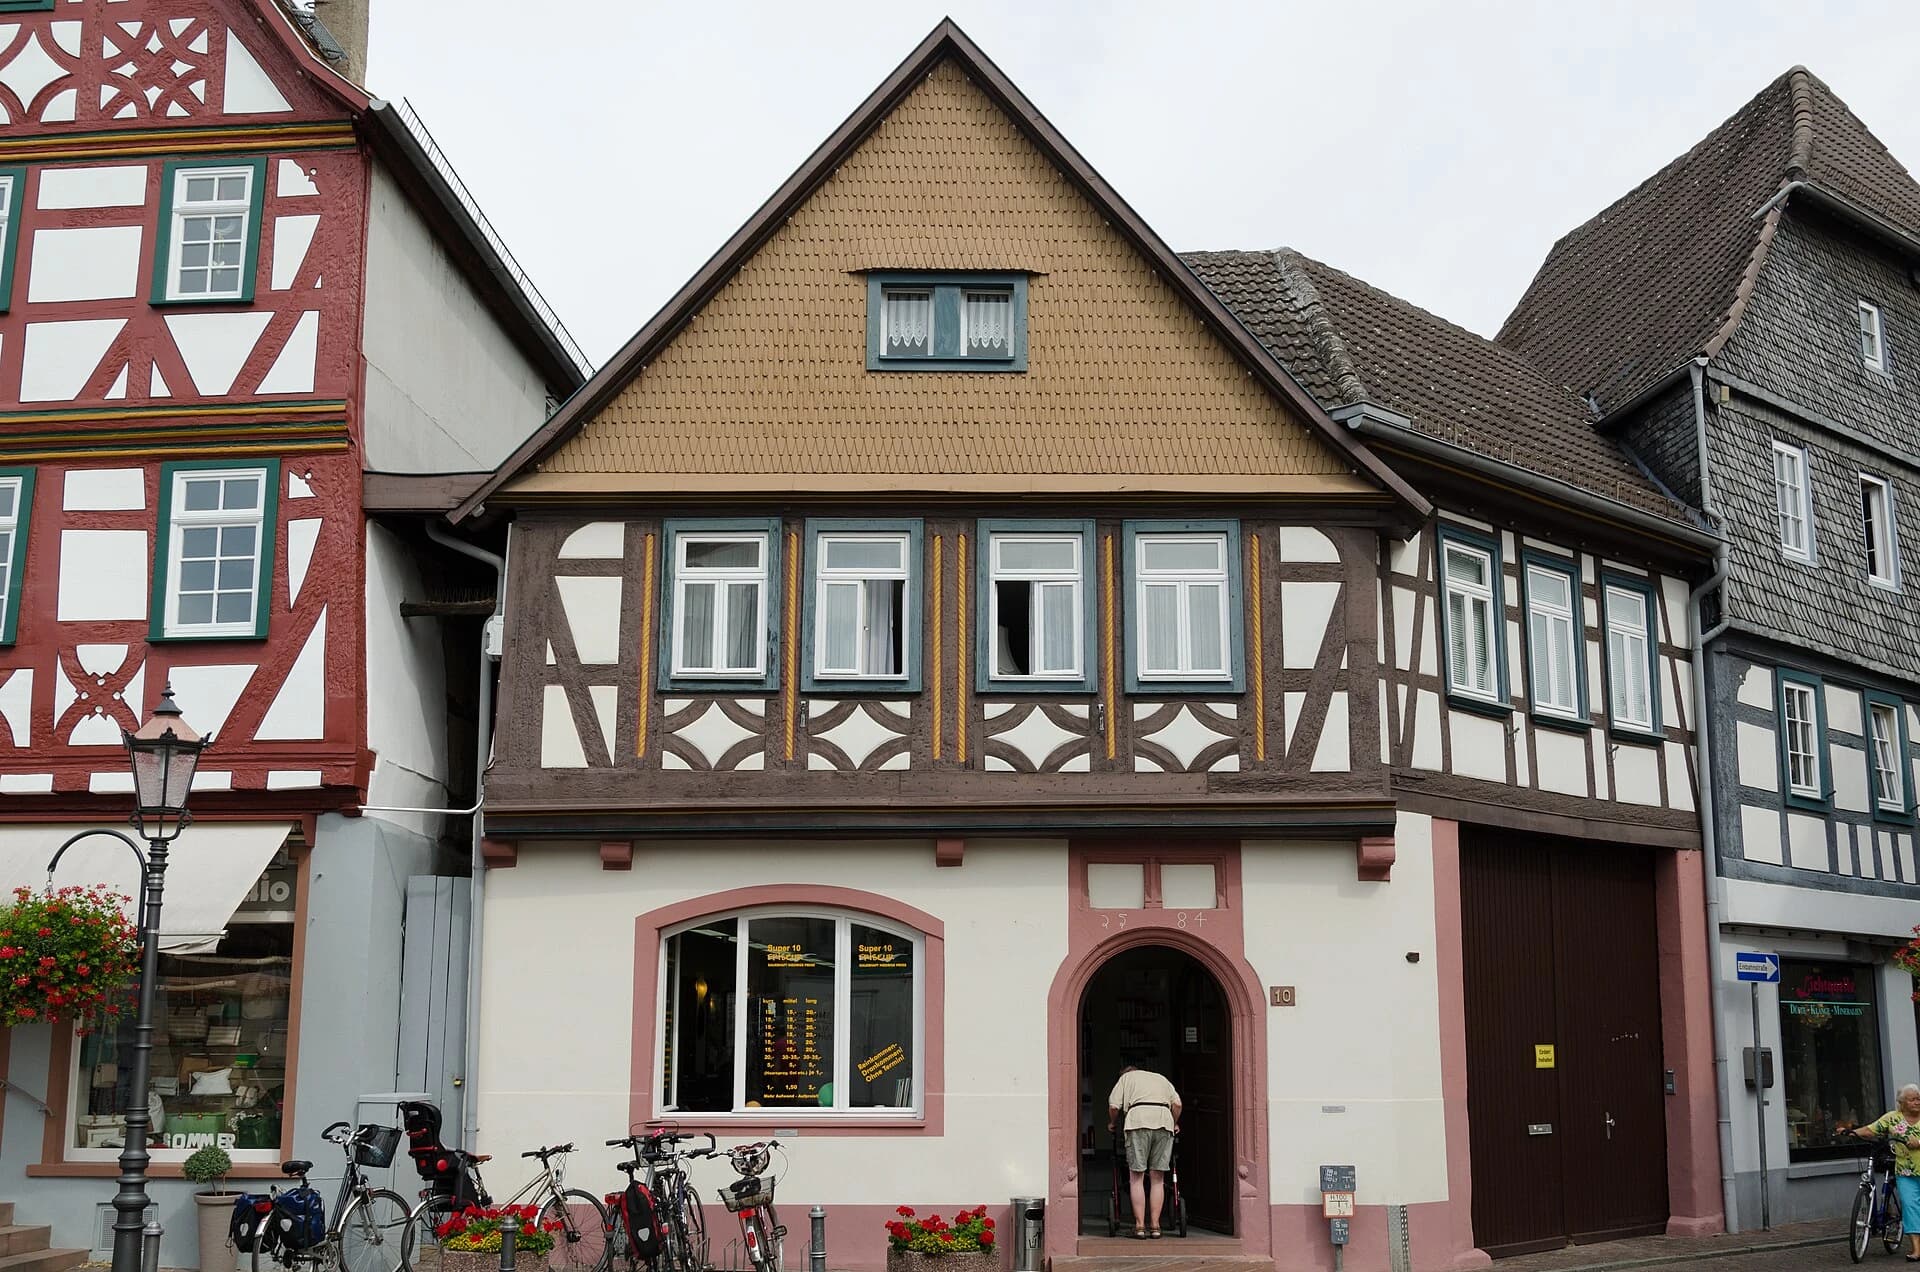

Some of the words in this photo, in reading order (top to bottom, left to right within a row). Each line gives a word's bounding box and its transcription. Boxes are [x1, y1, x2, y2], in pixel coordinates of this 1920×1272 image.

[767, 944, 790, 953] Super
[791, 944, 801, 952] 10
[858, 944, 881, 953] Super
[882, 944, 893, 952] 10
[1274, 989, 1291, 1003] 10
[163, 1132, 236, 1149] SOMMER
